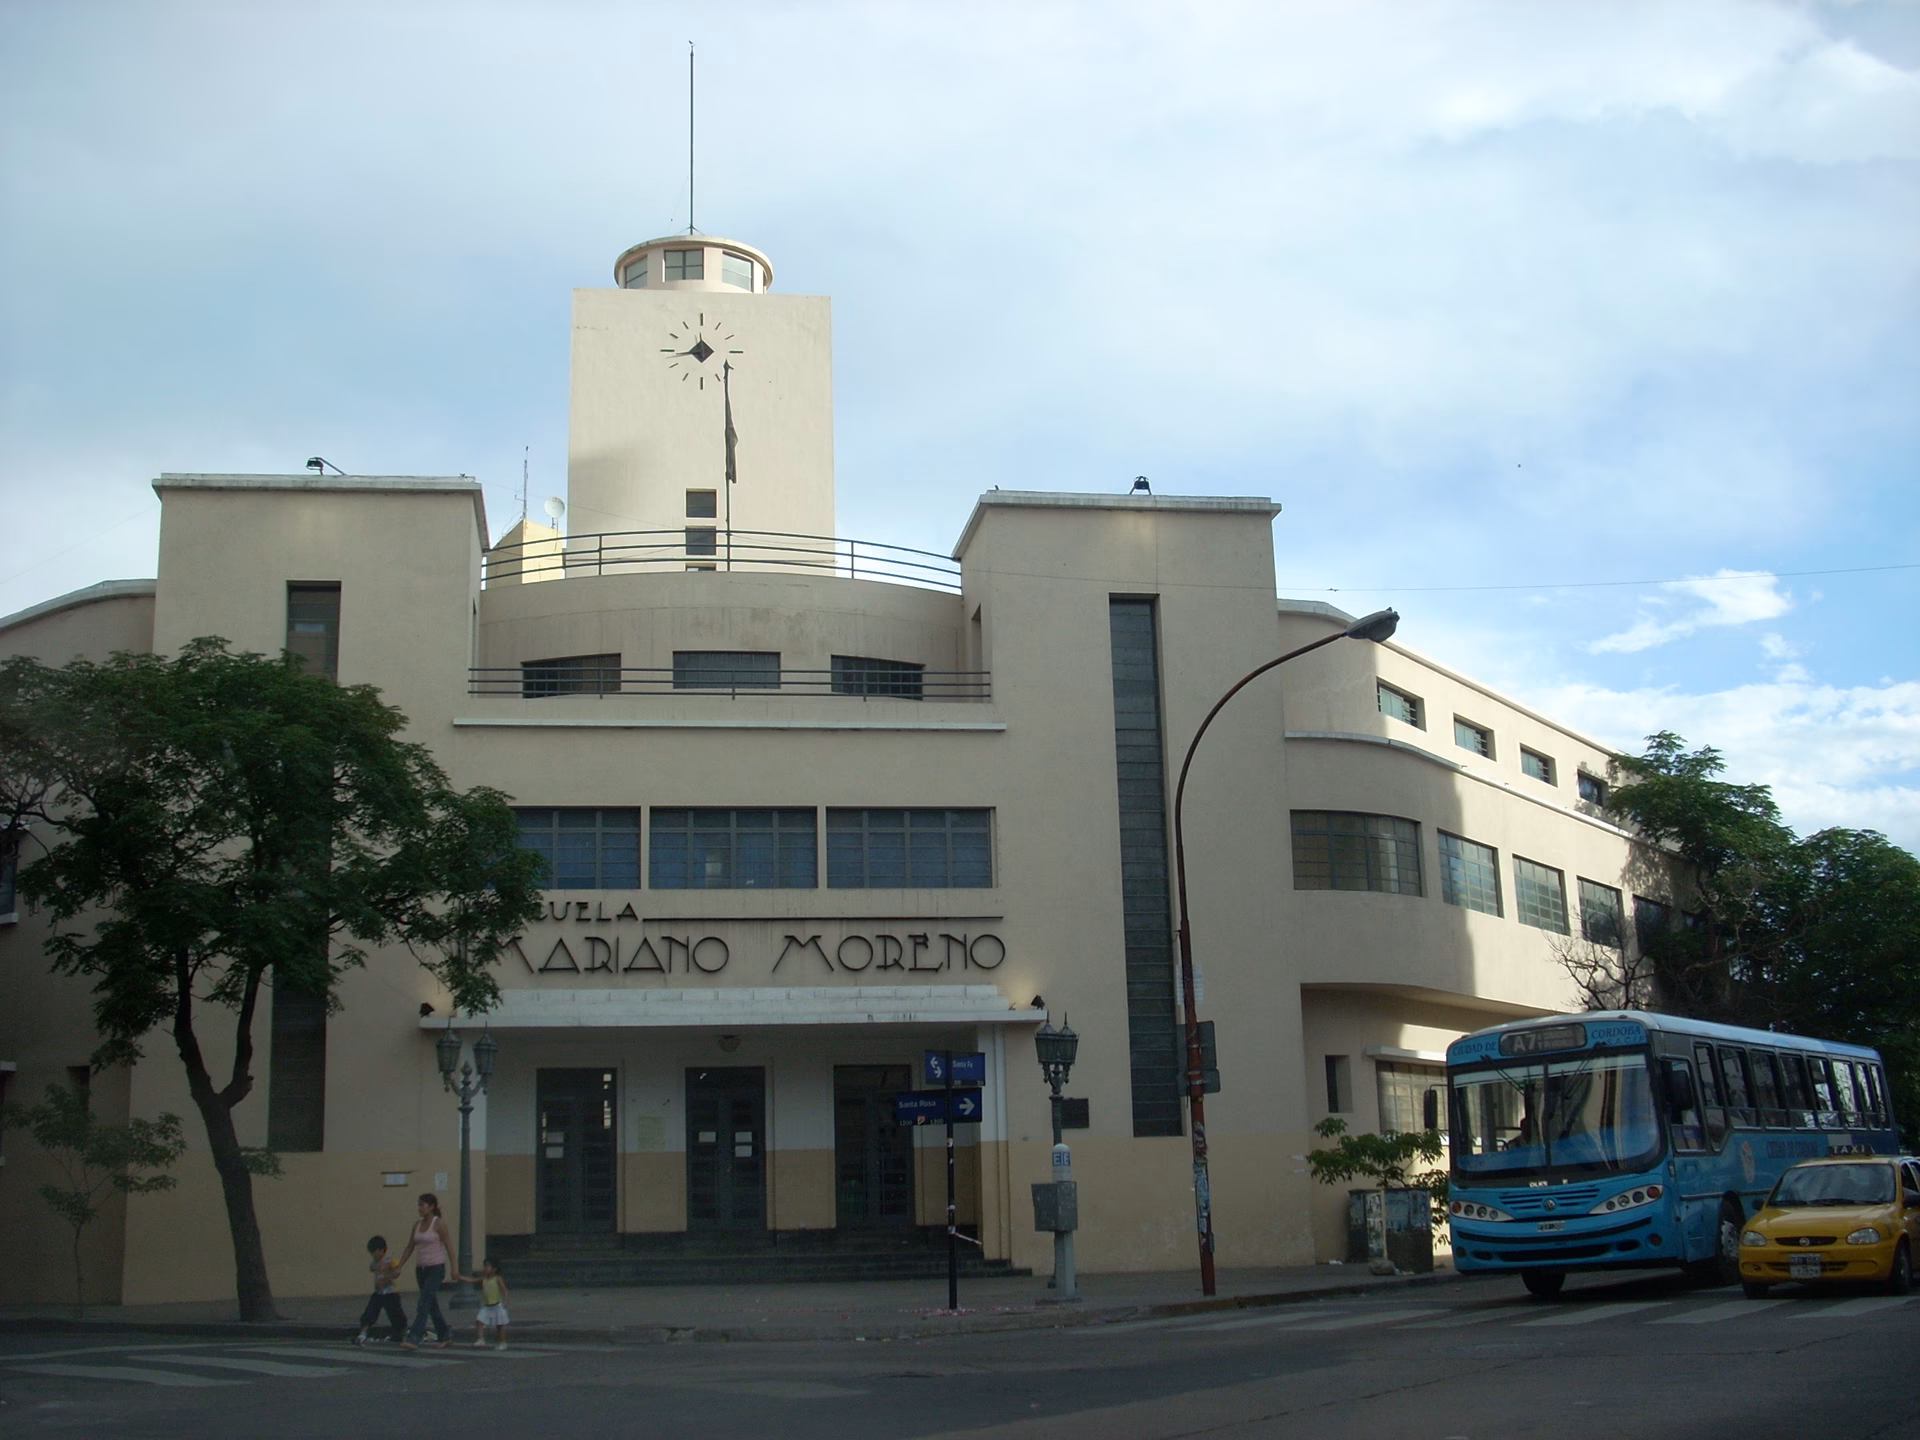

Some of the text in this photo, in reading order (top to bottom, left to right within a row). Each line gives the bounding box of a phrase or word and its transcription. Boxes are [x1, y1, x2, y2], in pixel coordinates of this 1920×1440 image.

[485, 932, 1005, 974] MARIANO MORENO
[1452, 1041, 1497, 1056] CIUDAD DE
[952, 1060, 966, 1068] Santa
[898, 1100, 936, 1109] Santa Rosa
[1833, 1144, 1865, 1154] TAXI
[1053, 1153, 1061, 1165] E
